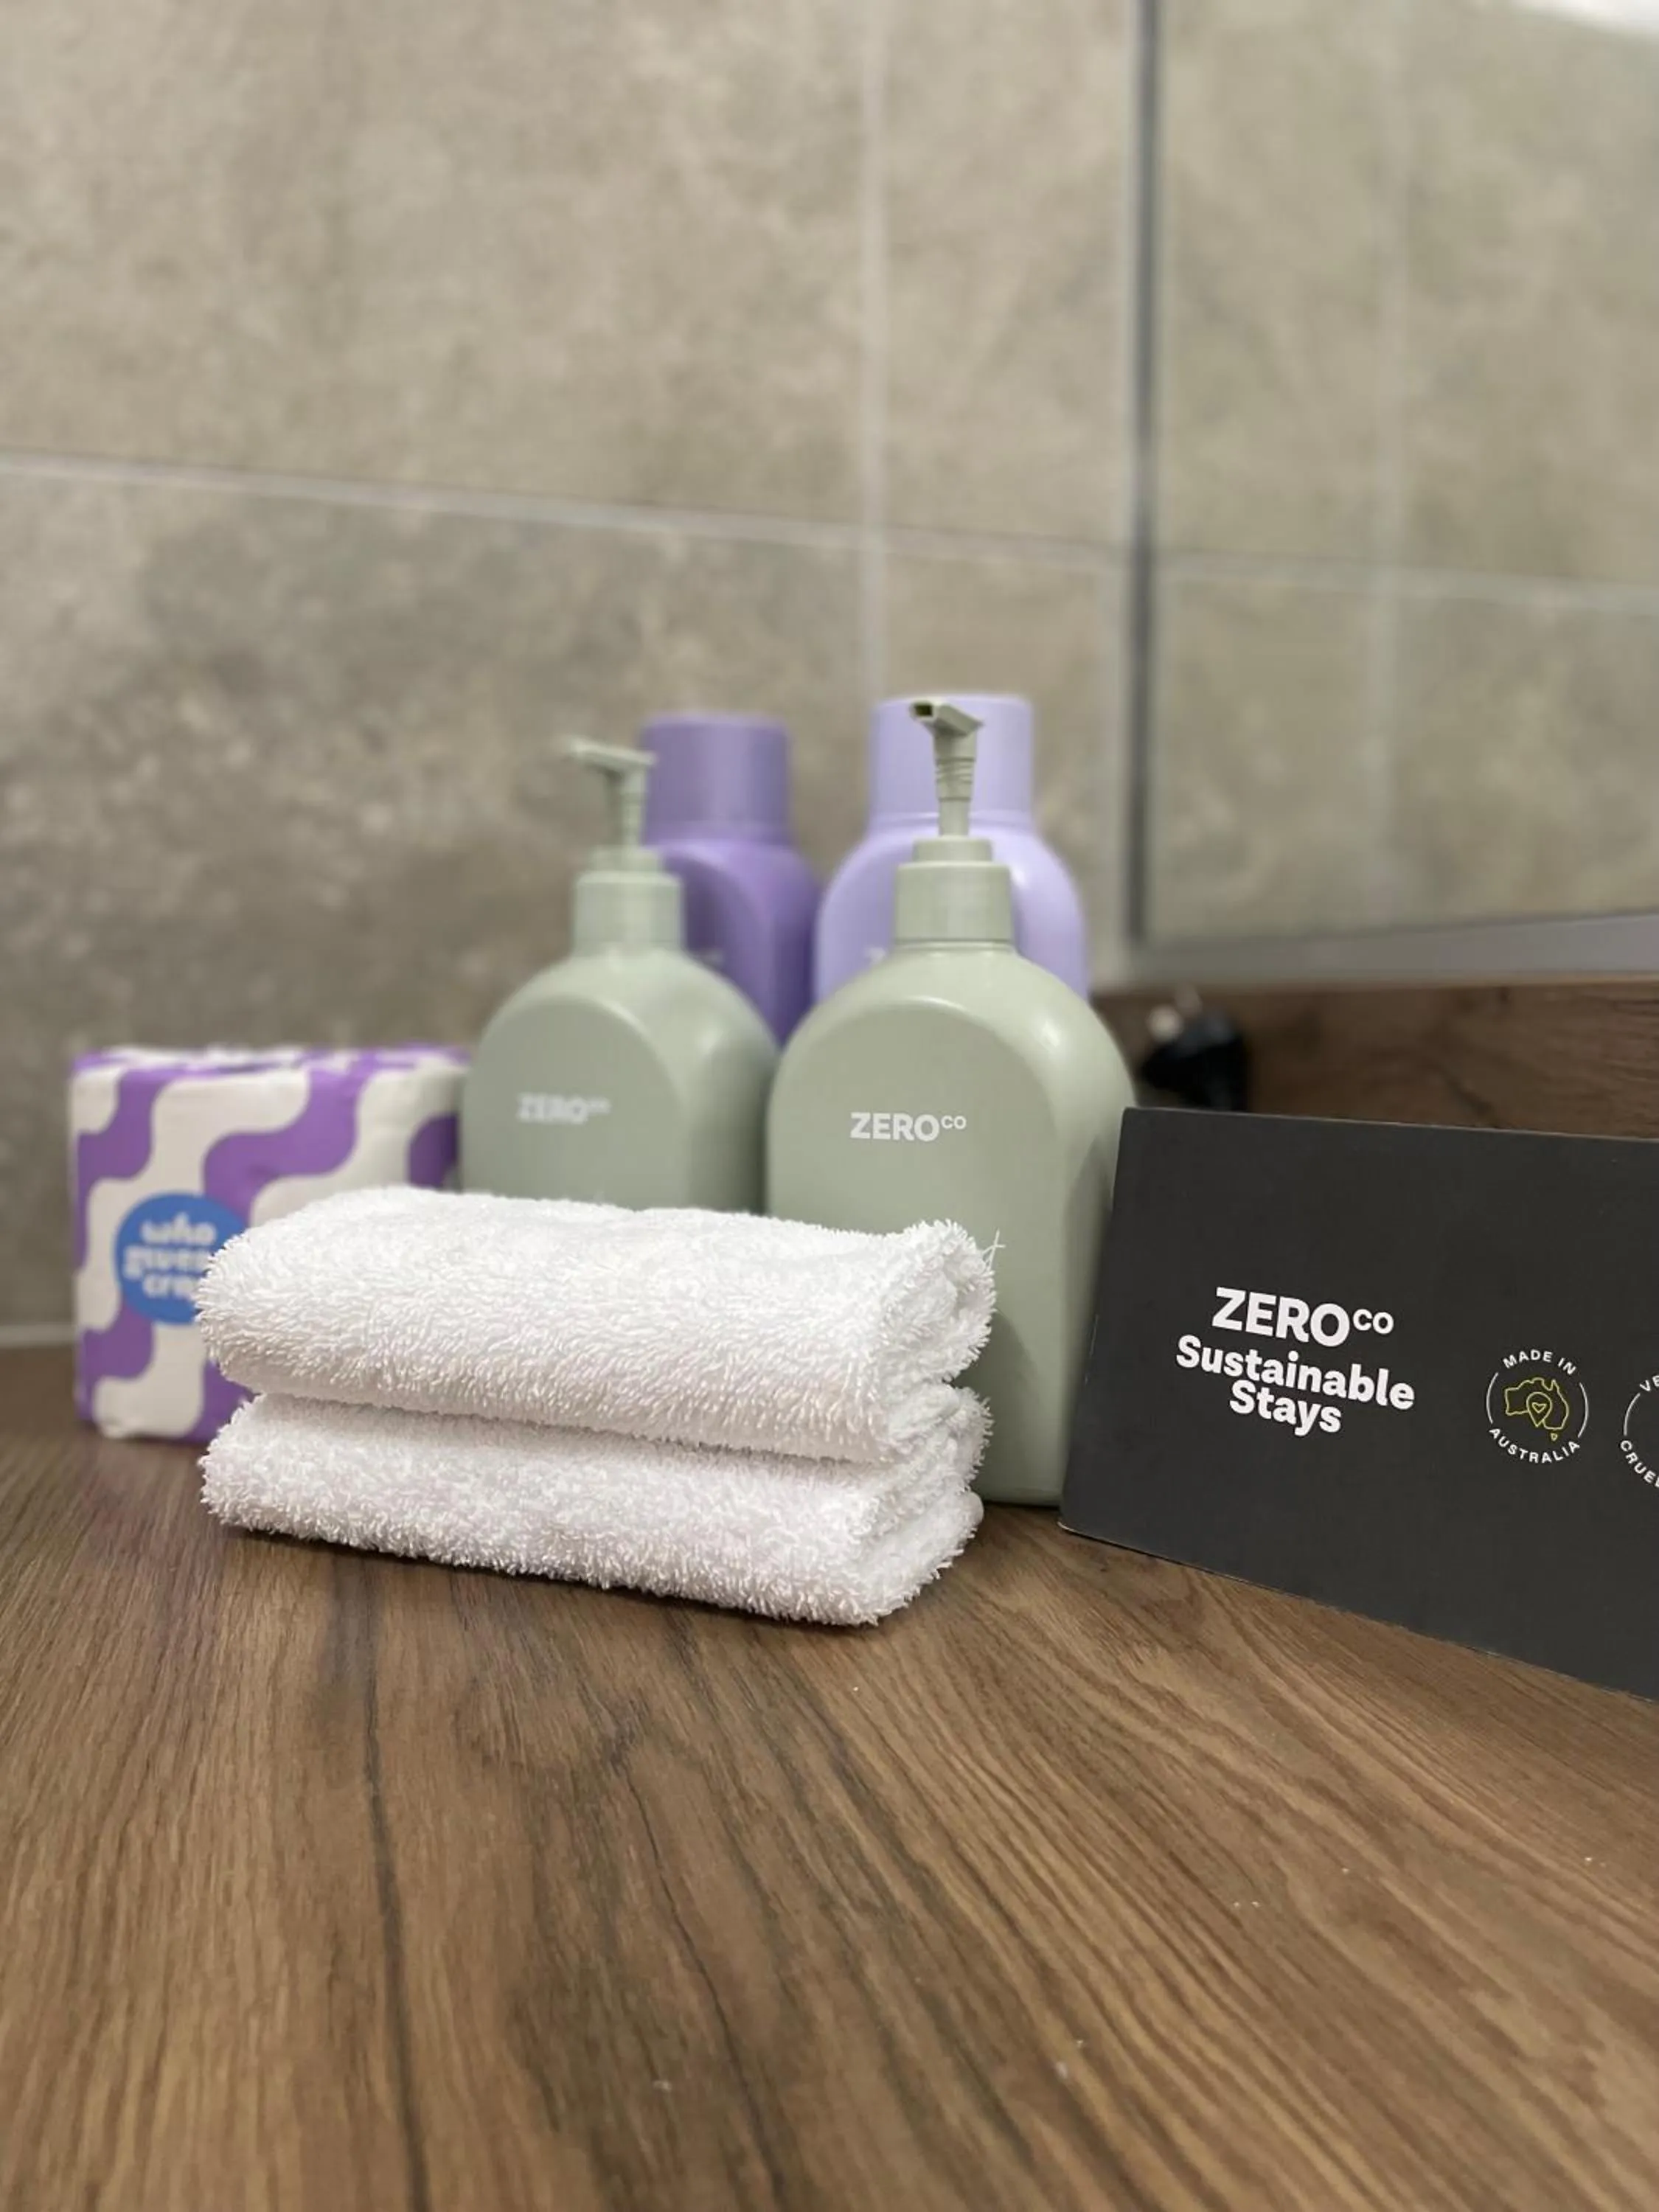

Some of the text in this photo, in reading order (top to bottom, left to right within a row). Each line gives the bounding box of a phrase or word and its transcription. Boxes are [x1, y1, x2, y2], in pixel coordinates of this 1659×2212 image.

[850, 1112, 967, 1141] ZERO CO
[1211, 1287, 1394, 1347] ZERO CO
[1176, 1334, 1415, 1411] Sustainable
[1503, 1349, 1577, 1375] MADE IN
[1229, 1379, 1342, 1437] Stays
[1489, 1427, 1581, 1464] AUSTRALIA
